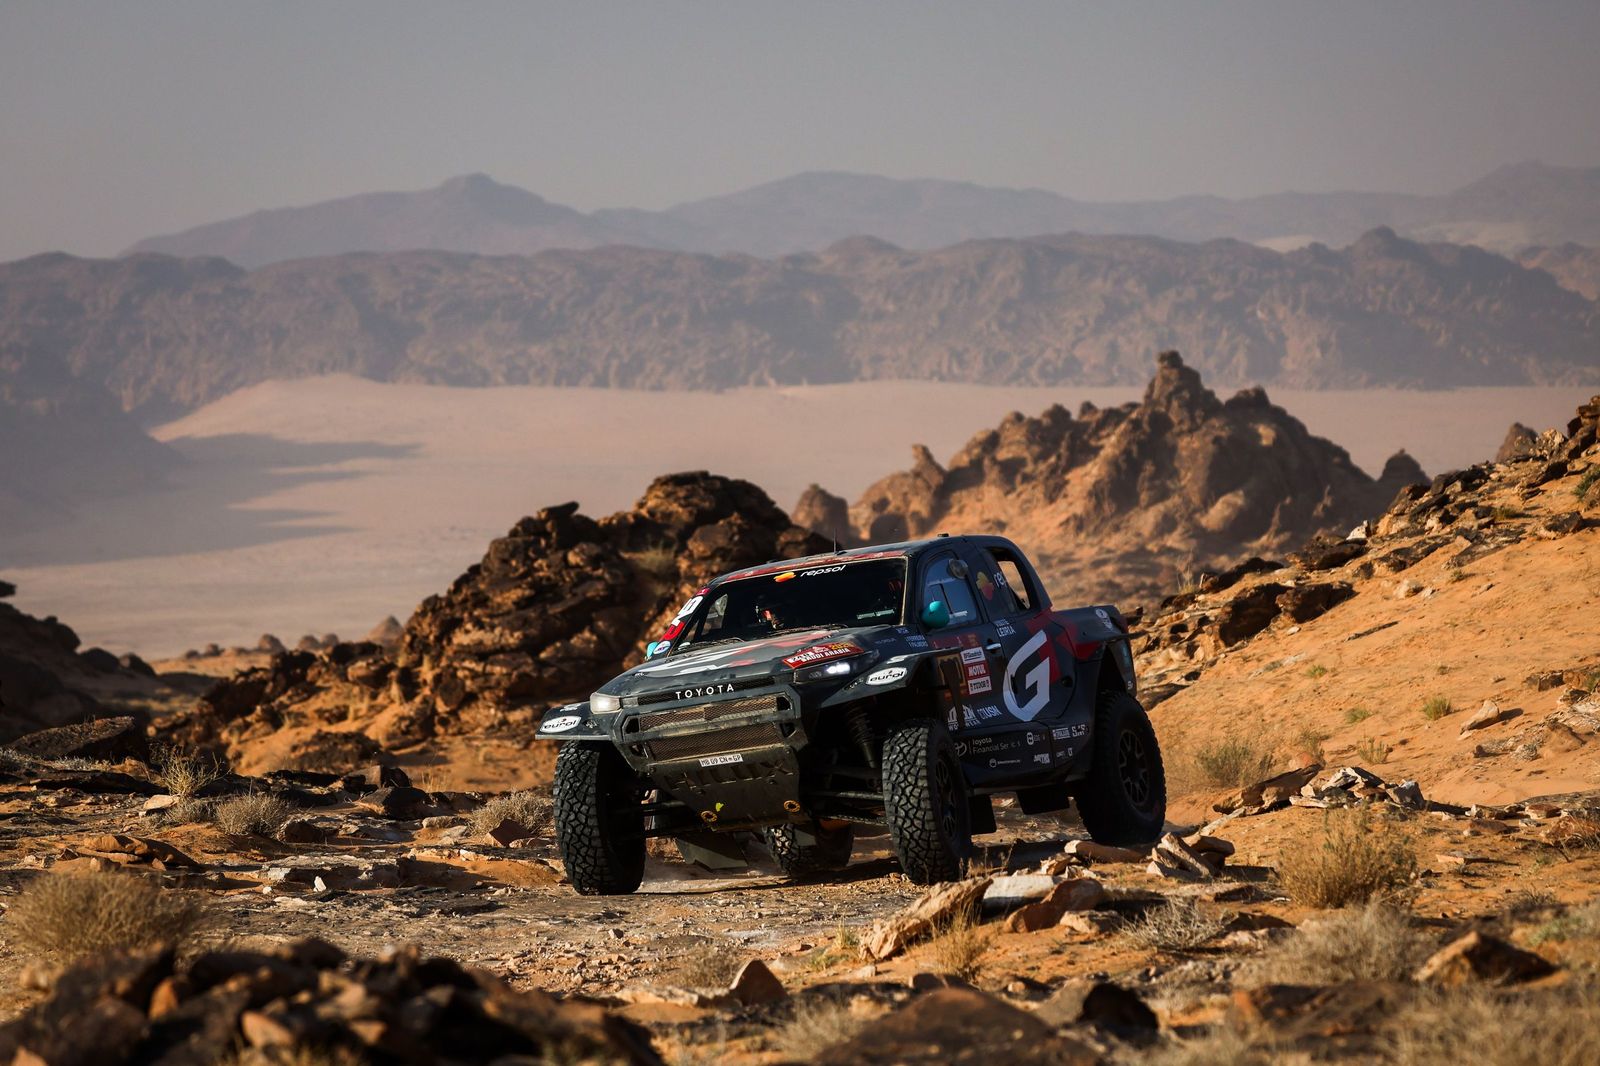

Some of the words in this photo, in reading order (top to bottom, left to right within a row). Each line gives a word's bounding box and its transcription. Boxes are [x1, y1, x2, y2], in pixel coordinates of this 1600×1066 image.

[800, 564, 847, 578] repsol
[825, 648, 851, 657] ARABIA
[869, 671, 904, 683] eurol
[675, 683, 734, 700] TOYOTA
[544, 719, 577, 729] eurol
